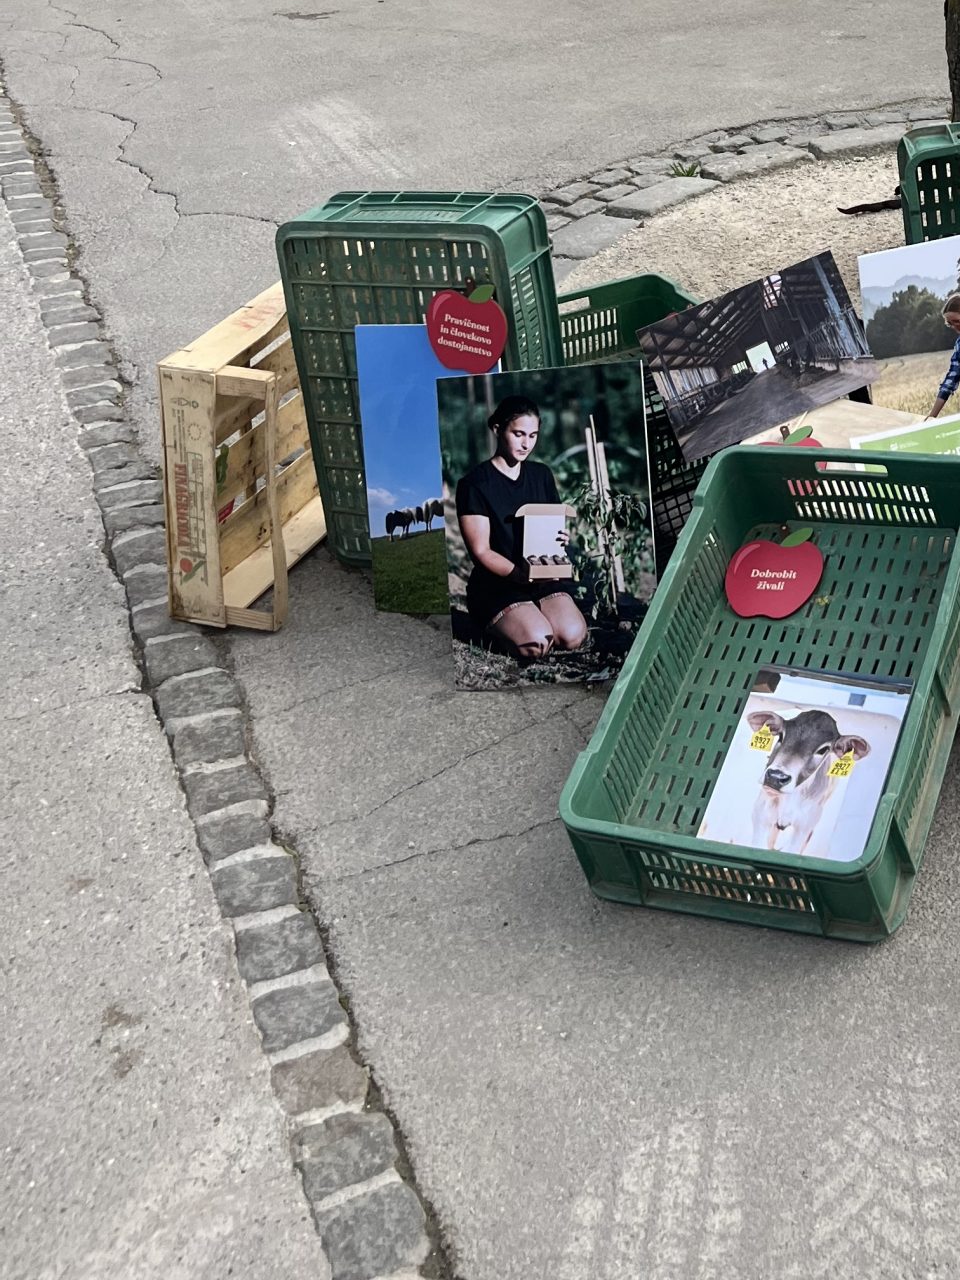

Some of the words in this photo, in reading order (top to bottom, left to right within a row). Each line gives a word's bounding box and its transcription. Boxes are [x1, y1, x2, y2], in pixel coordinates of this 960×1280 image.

[444, 313, 490, 333] Pravičnost
[439, 324, 449, 334] in
[450, 326, 492, 345] človekovo
[437, 335, 492, 357] dostojanstvo
[750, 568, 798, 580] Dobrobit
[756, 580, 785, 591] živali
